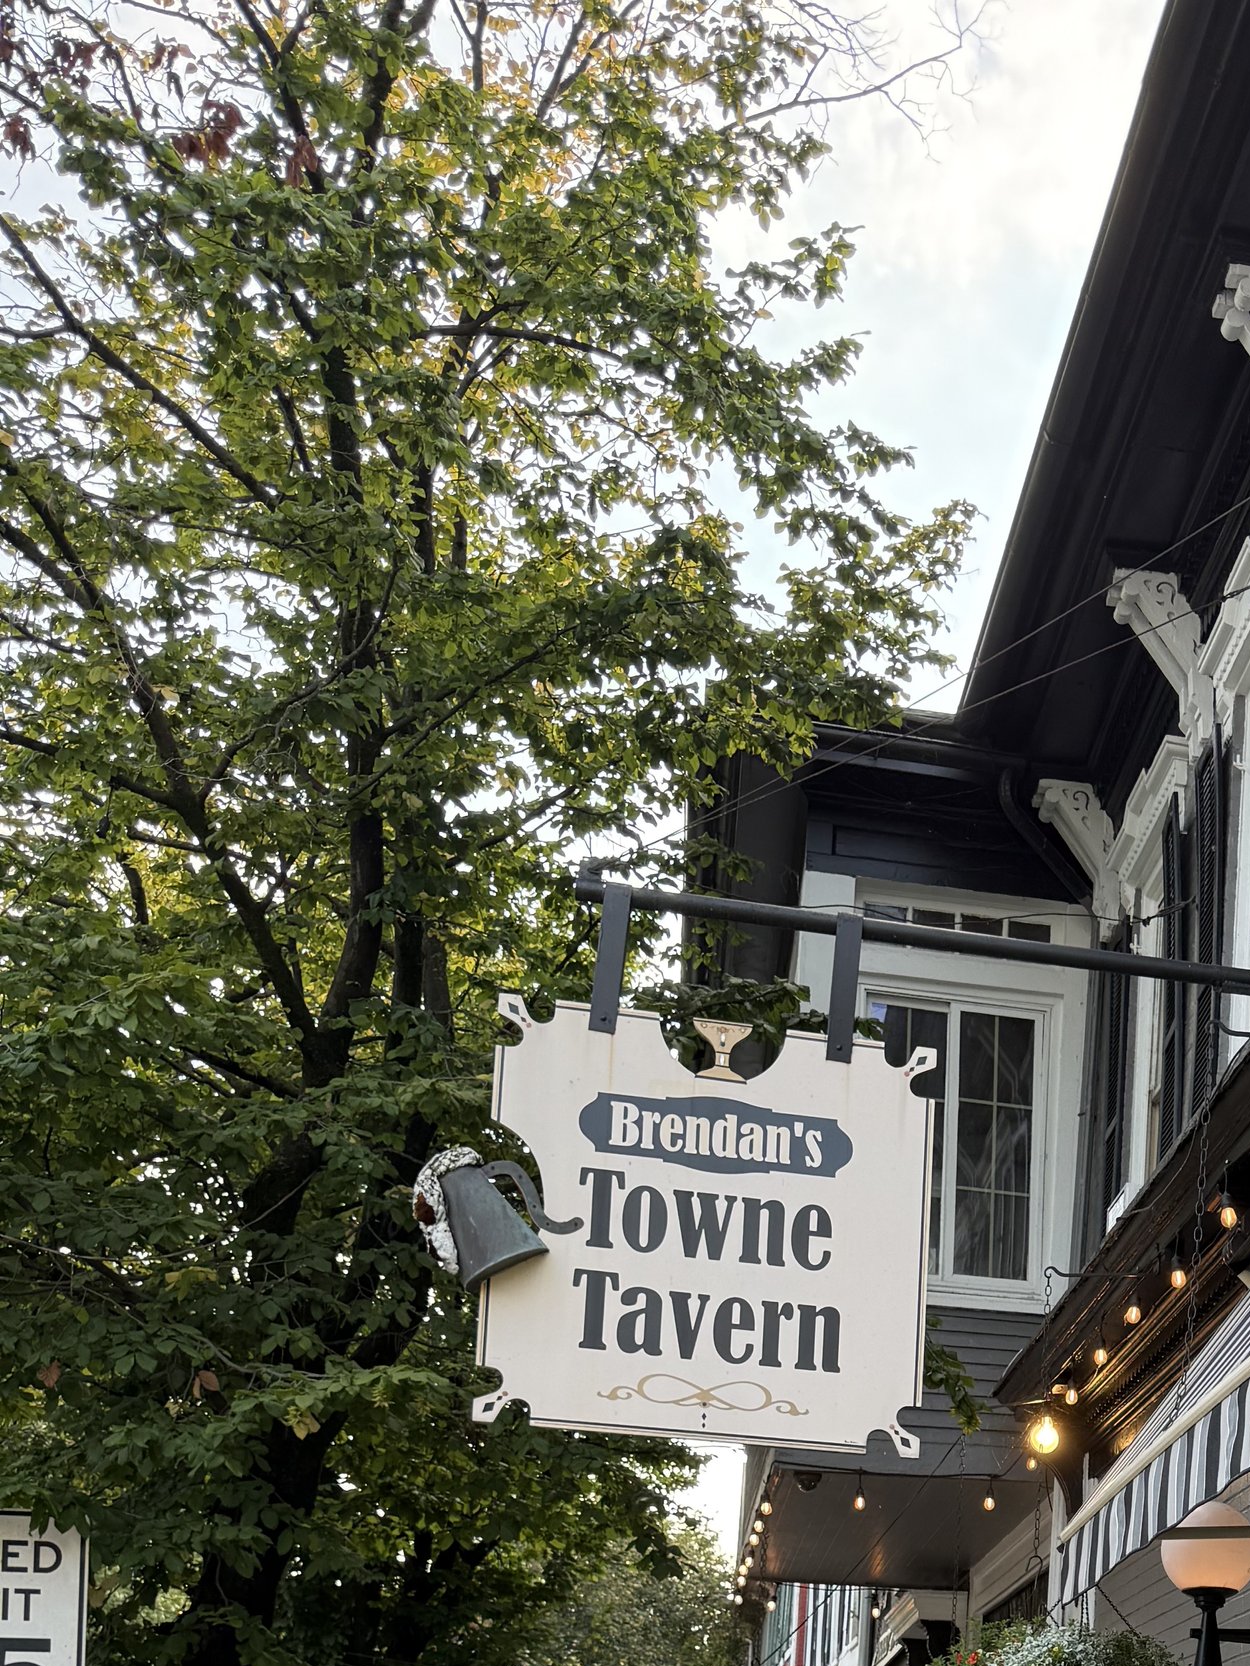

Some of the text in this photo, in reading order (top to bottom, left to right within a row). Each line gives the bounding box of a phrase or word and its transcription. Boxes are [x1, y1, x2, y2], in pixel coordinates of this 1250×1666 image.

[608, 1100, 823, 1168] Brendan's
[579, 1167, 833, 1271] Towne
[572, 1268, 841, 1374] Tavern
